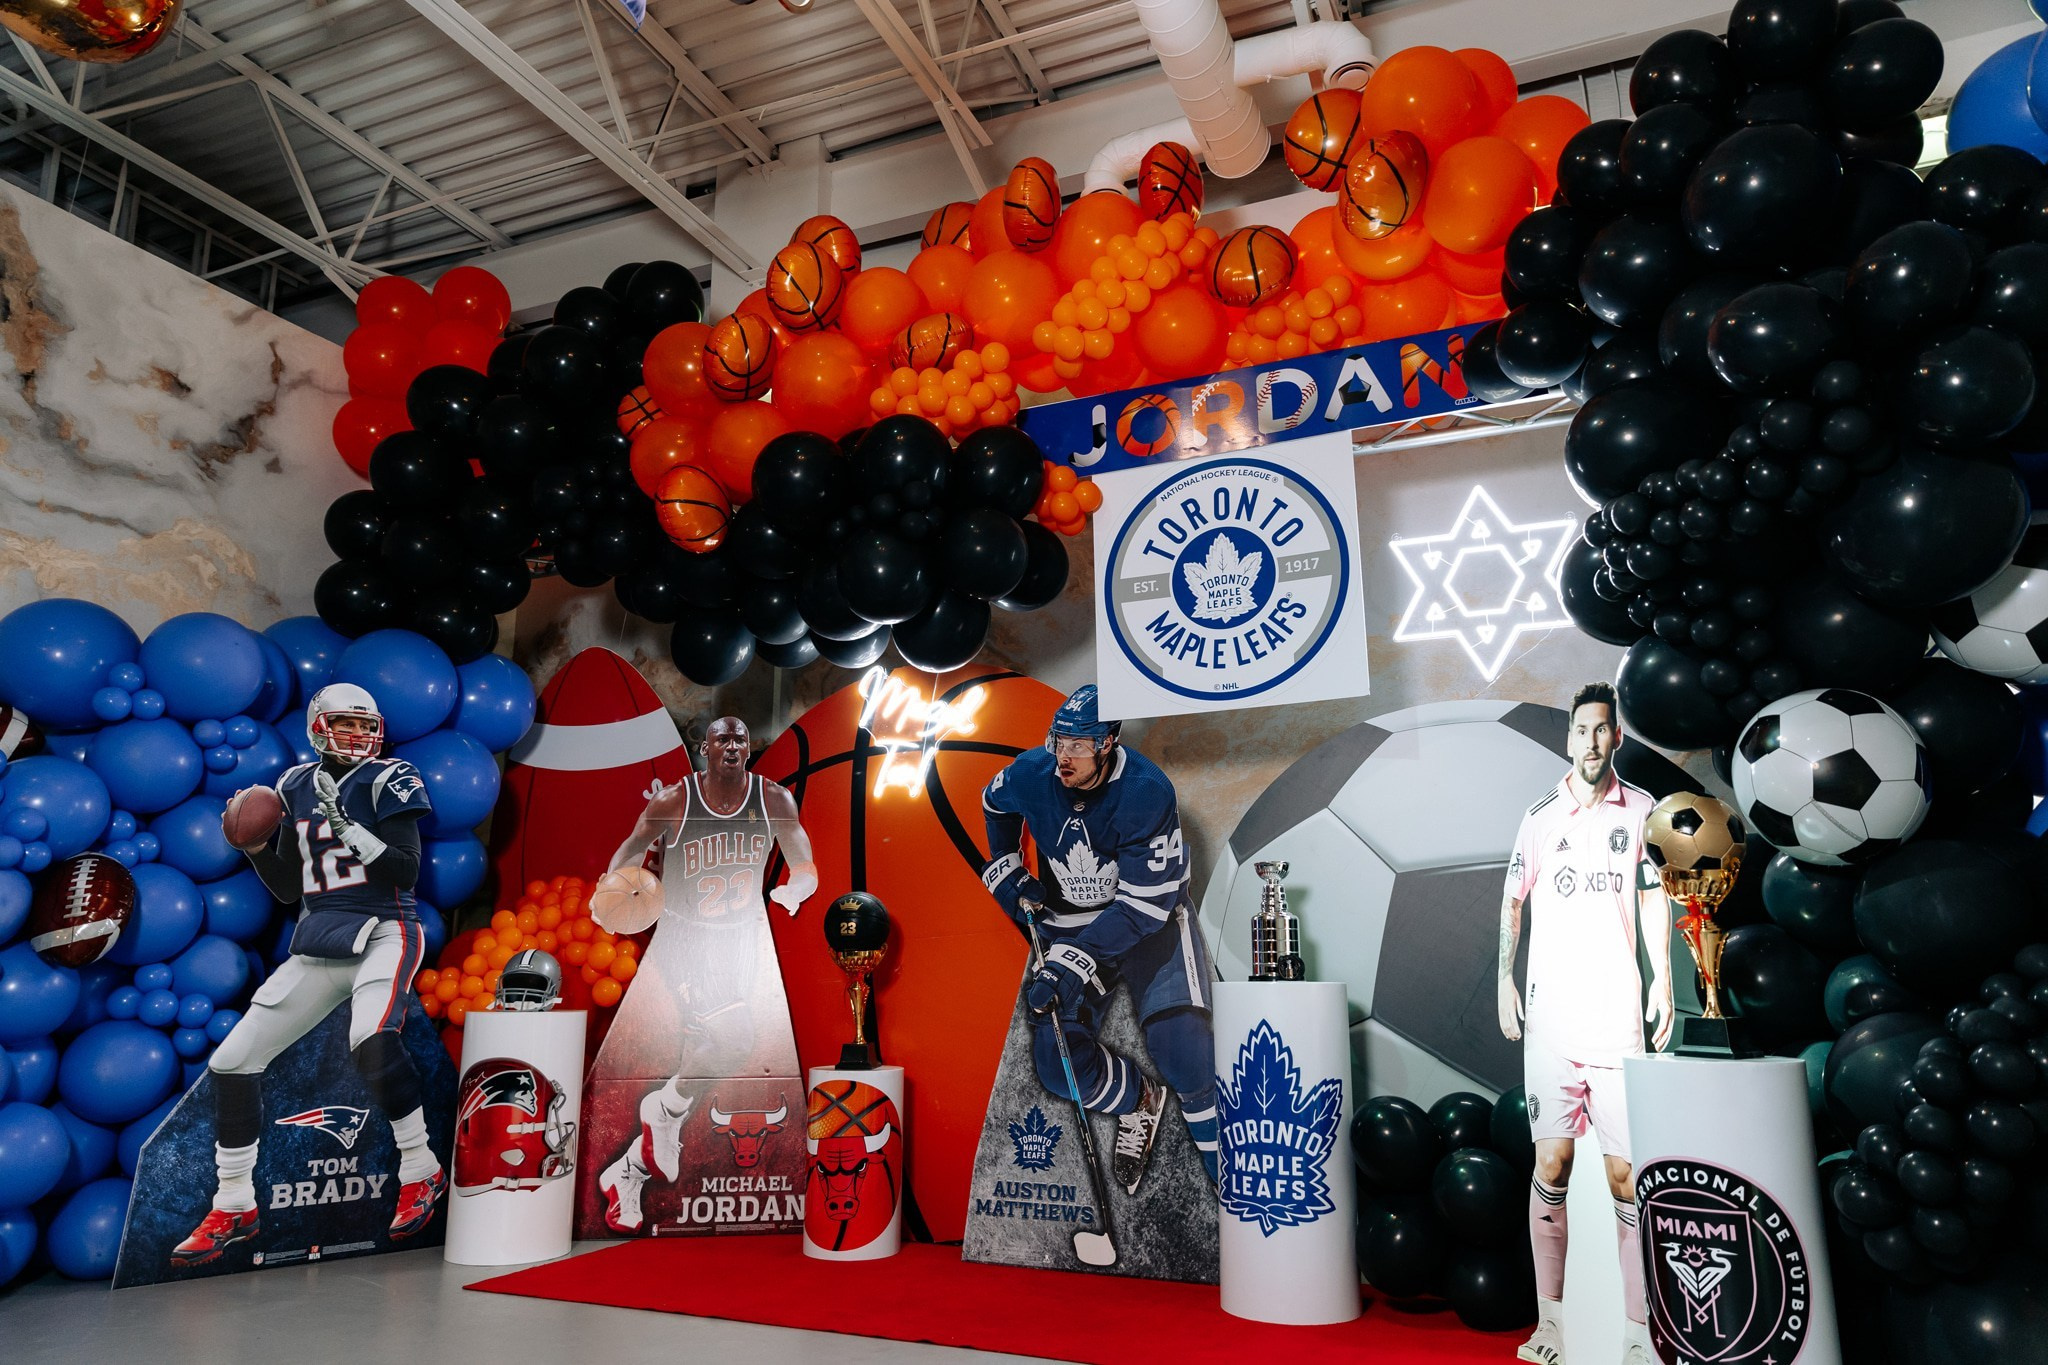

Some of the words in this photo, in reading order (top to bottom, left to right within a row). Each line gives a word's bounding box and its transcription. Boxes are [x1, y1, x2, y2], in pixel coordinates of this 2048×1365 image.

[1068, 333, 1469, 467] JORDAN
[1160, 477, 1200, 502] NATIONAL
[1201, 469, 1237, 481] HOCKEY
[1238, 469, 1271, 481] LEAGUE
[1143, 487, 1304, 560] TORONTO
[1285, 557, 1319, 574] 1917
[1133, 580, 1159, 594] EST.
[1201, 574, 1250, 591] TORONTO
[1208, 588, 1241, 599] MAPLE
[1207, 597, 1242, 609] LEAFS
[1145, 610, 1227, 669] MAPLE
[1233, 597, 1307, 666] LEAFS
[1222, 682, 1239, 691] NHL
[858, 665, 985, 737] Mzl
[295, 819, 368, 895] 12
[683, 832, 766, 879] BULLS
[1147, 828, 1183, 872] 34
[697, 869, 754, 918] 23
[1061, 876, 1112, 886] TORONTO
[1070, 885, 1106, 893] MAPLE
[1072, 892, 1108, 900] LEAFS
[840, 922, 857, 935] 23
[1018, 1134, 1052, 1147] TORONTO
[1023, 1143, 1046, 1153] MAPLE
[1223, 1119, 1322, 1157] TORONTO
[307, 1156, 359, 1177] TOM
[1022, 1151, 1046, 1160] LEAFS
[1234, 1151, 1304, 1176] MAPLE
[269, 1174, 389, 1210] BRADY
[701, 1175, 793, 1193] MICHAEL
[993, 1181, 1077, 1202] AUSTON
[1231, 1174, 1306, 1200] LEAFS
[676, 1194, 805, 1224] JORDAN
[975, 1199, 1095, 1224] MATTHEWS
[1656, 1215, 1737, 1241] MIAMI
[1766, 1212, 1791, 1242] DE
[1781, 1251, 1806, 1342] FÚTBOL
